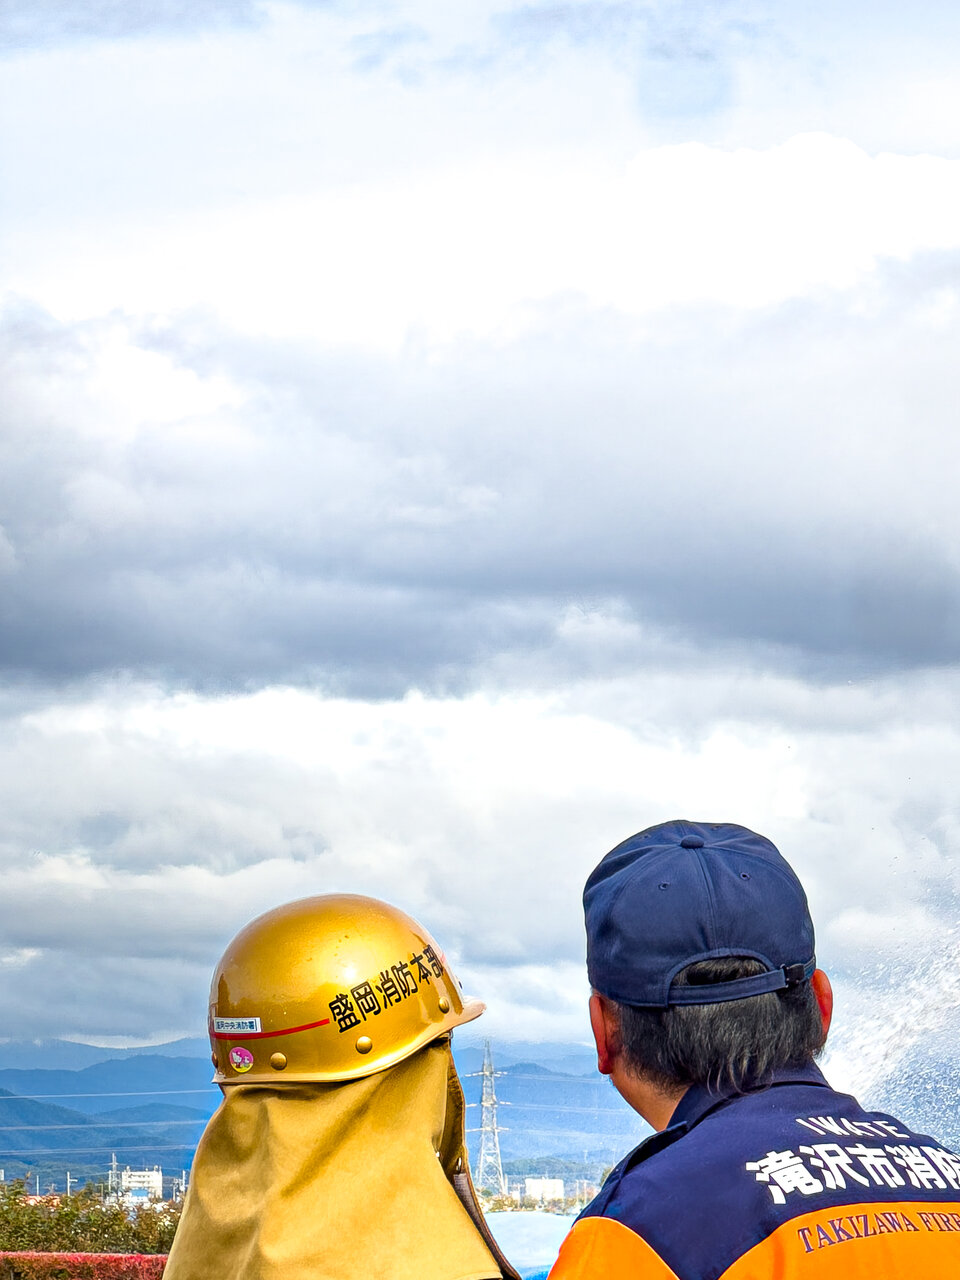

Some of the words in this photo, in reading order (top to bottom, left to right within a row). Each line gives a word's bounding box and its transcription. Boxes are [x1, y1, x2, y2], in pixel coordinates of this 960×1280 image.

[328, 943, 444, 1034] 盛岡消防本部
[796, 1117, 909, 1138] IWATE
[797, 1211, 920, 1253] TAKIZAWA
